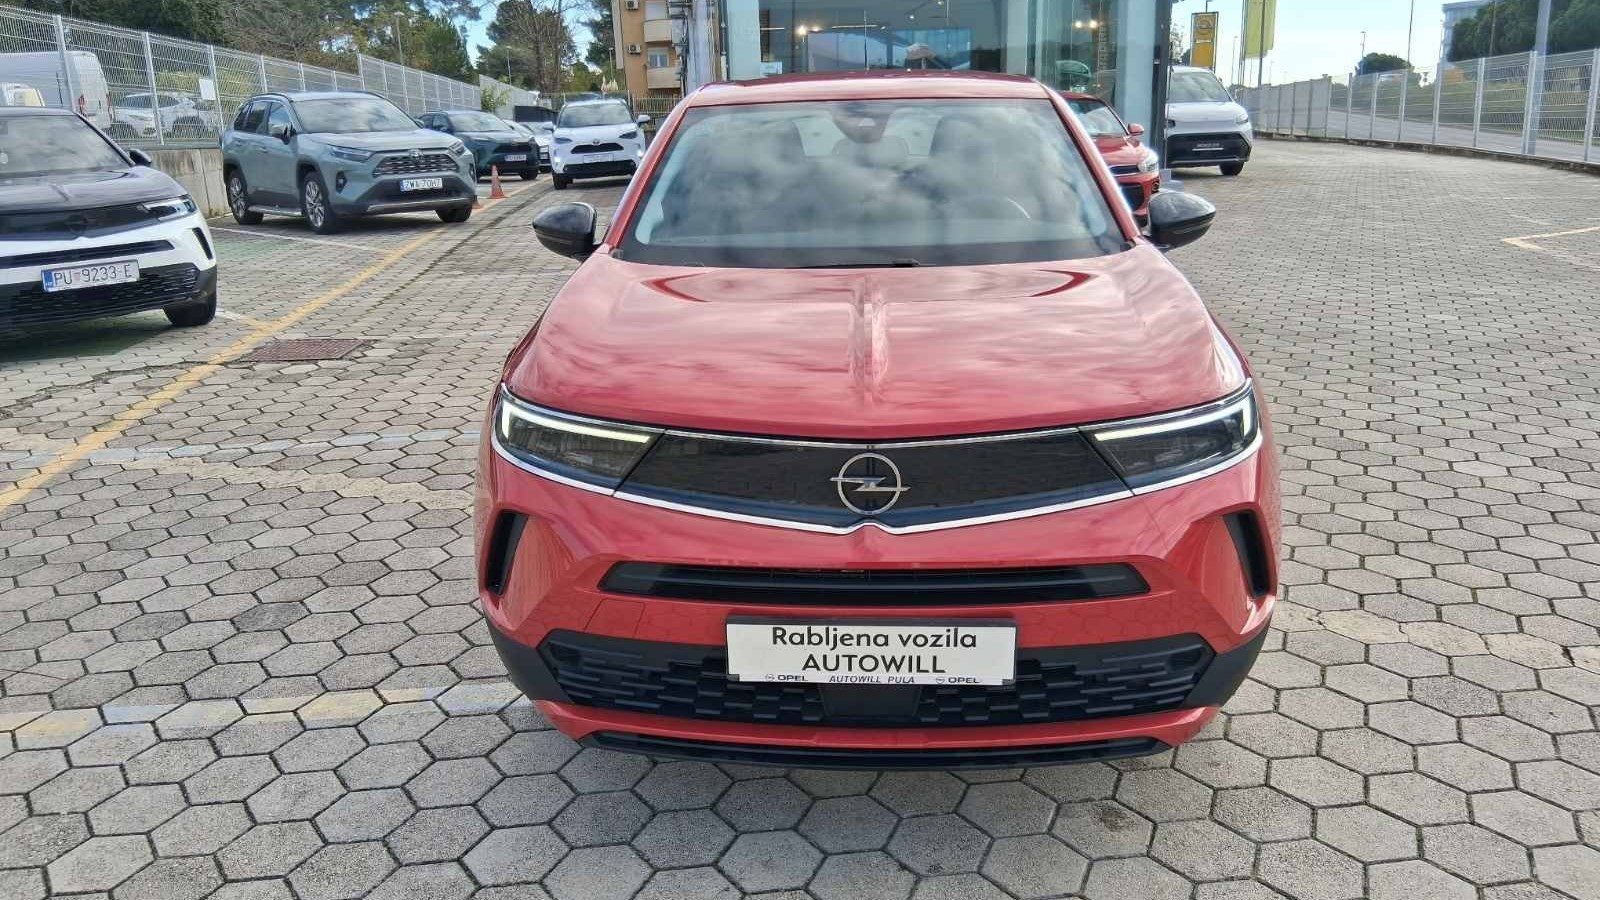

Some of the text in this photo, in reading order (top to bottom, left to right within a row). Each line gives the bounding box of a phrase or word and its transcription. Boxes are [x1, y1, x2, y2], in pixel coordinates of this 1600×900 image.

[53, 271, 73, 286] PU
[772, 626, 977, 650] Rabljena vozila
[801, 653, 946, 673] AUTOWILL
[777, 674, 979, 684] OPEL AUTOWILL PULA OPEL
